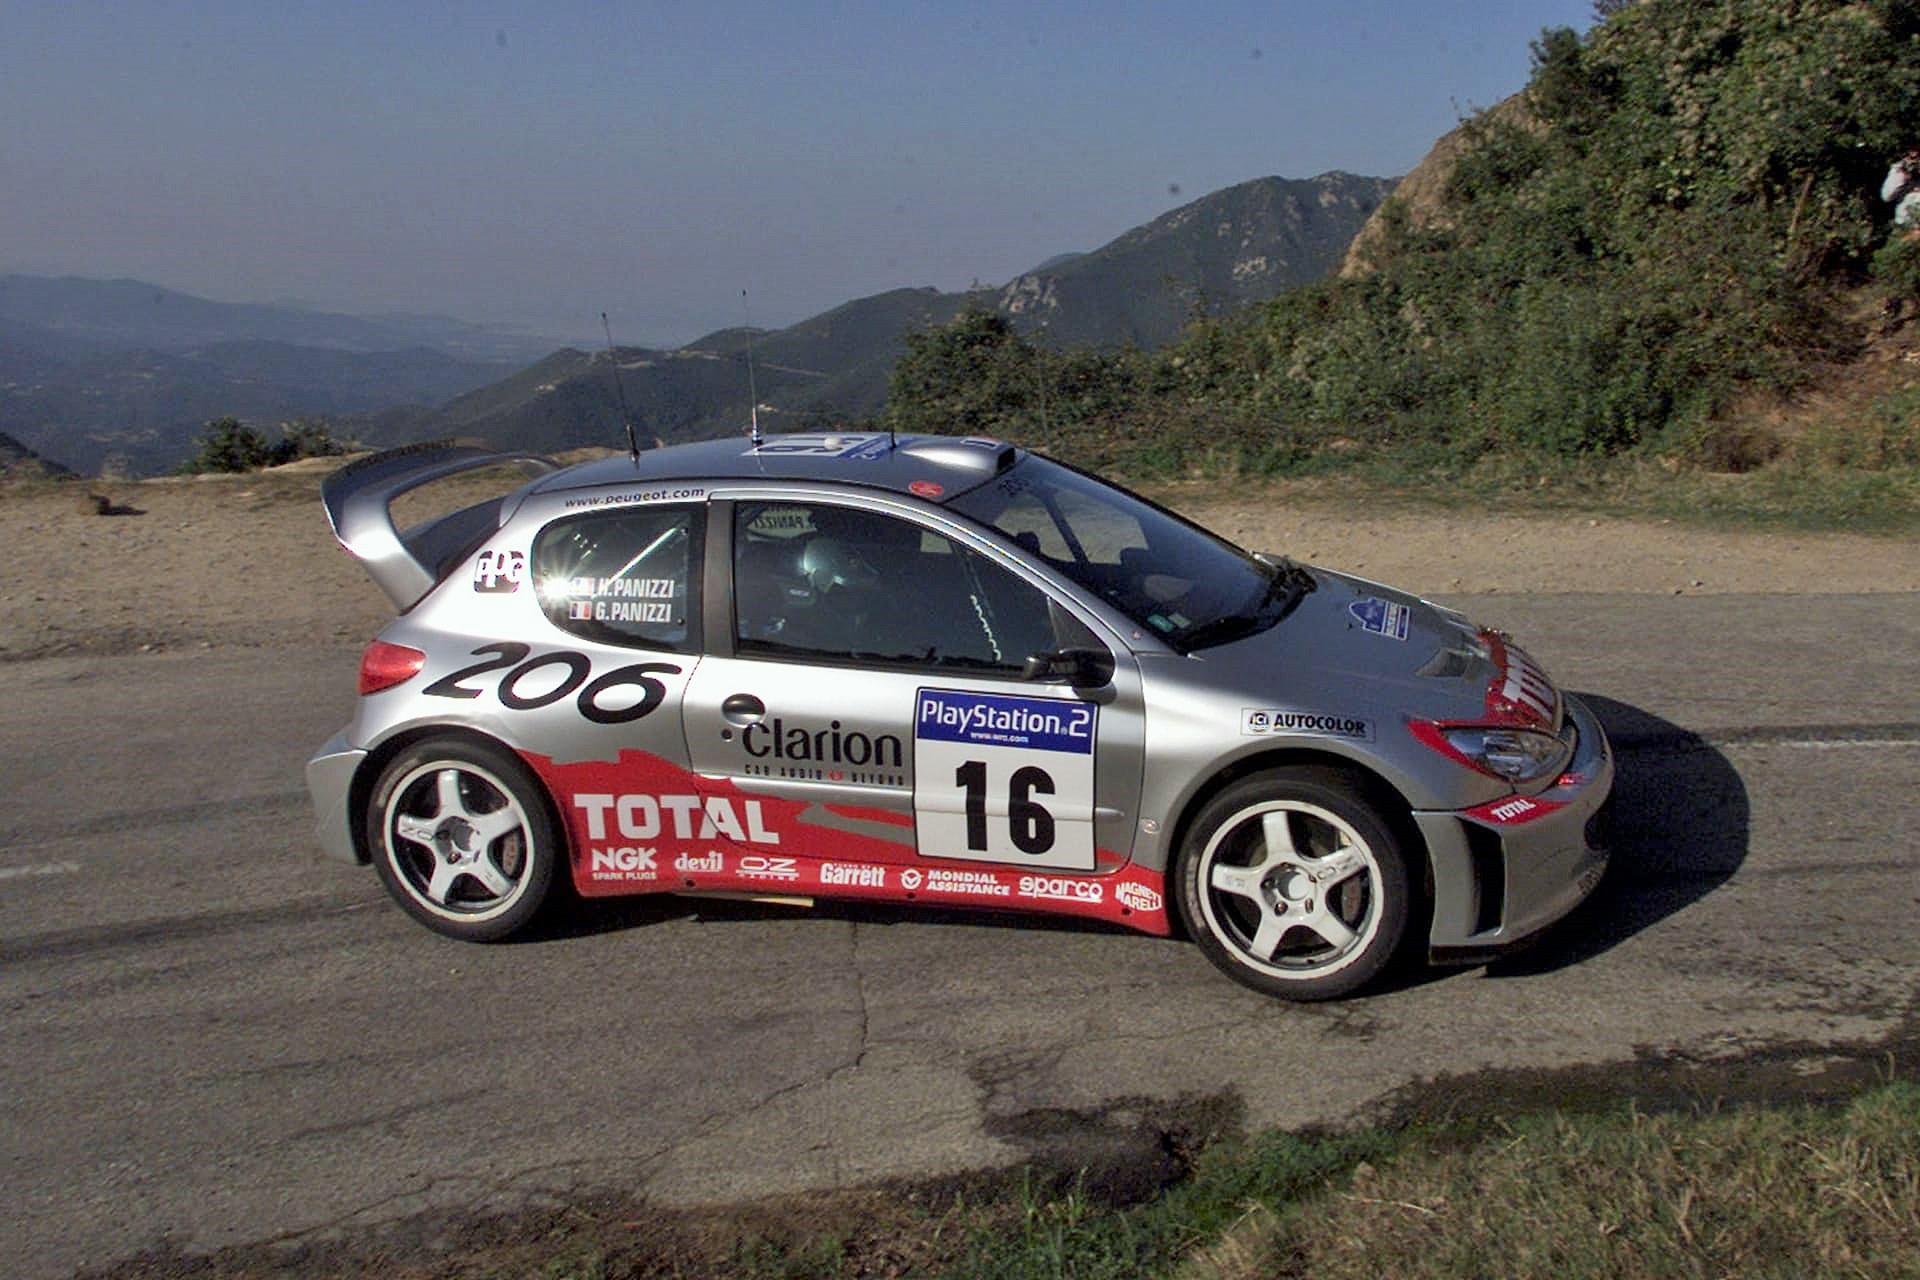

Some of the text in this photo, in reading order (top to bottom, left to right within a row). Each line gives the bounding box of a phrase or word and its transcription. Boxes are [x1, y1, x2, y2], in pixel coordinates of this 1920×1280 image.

[565, 488, 704, 508] www.peugeot.com
[422, 641, 682, 724] 206
[1274, 714, 1366, 735] AUTOCOLOR
[742, 718, 903, 767] Clarion
[573, 793, 780, 845] TOTAL
[956, 760, 1056, 855] 16
[1490, 798, 1537, 821] TOTAL
[591, 847, 657, 871] NGK
[674, 850, 723, 873] devil
[820, 862, 886, 887] Garrett
[927, 869, 999, 885] MONDIAL
[926, 880, 1011, 897] ASSISTANCE
[1018, 876, 1104, 904] sparco
